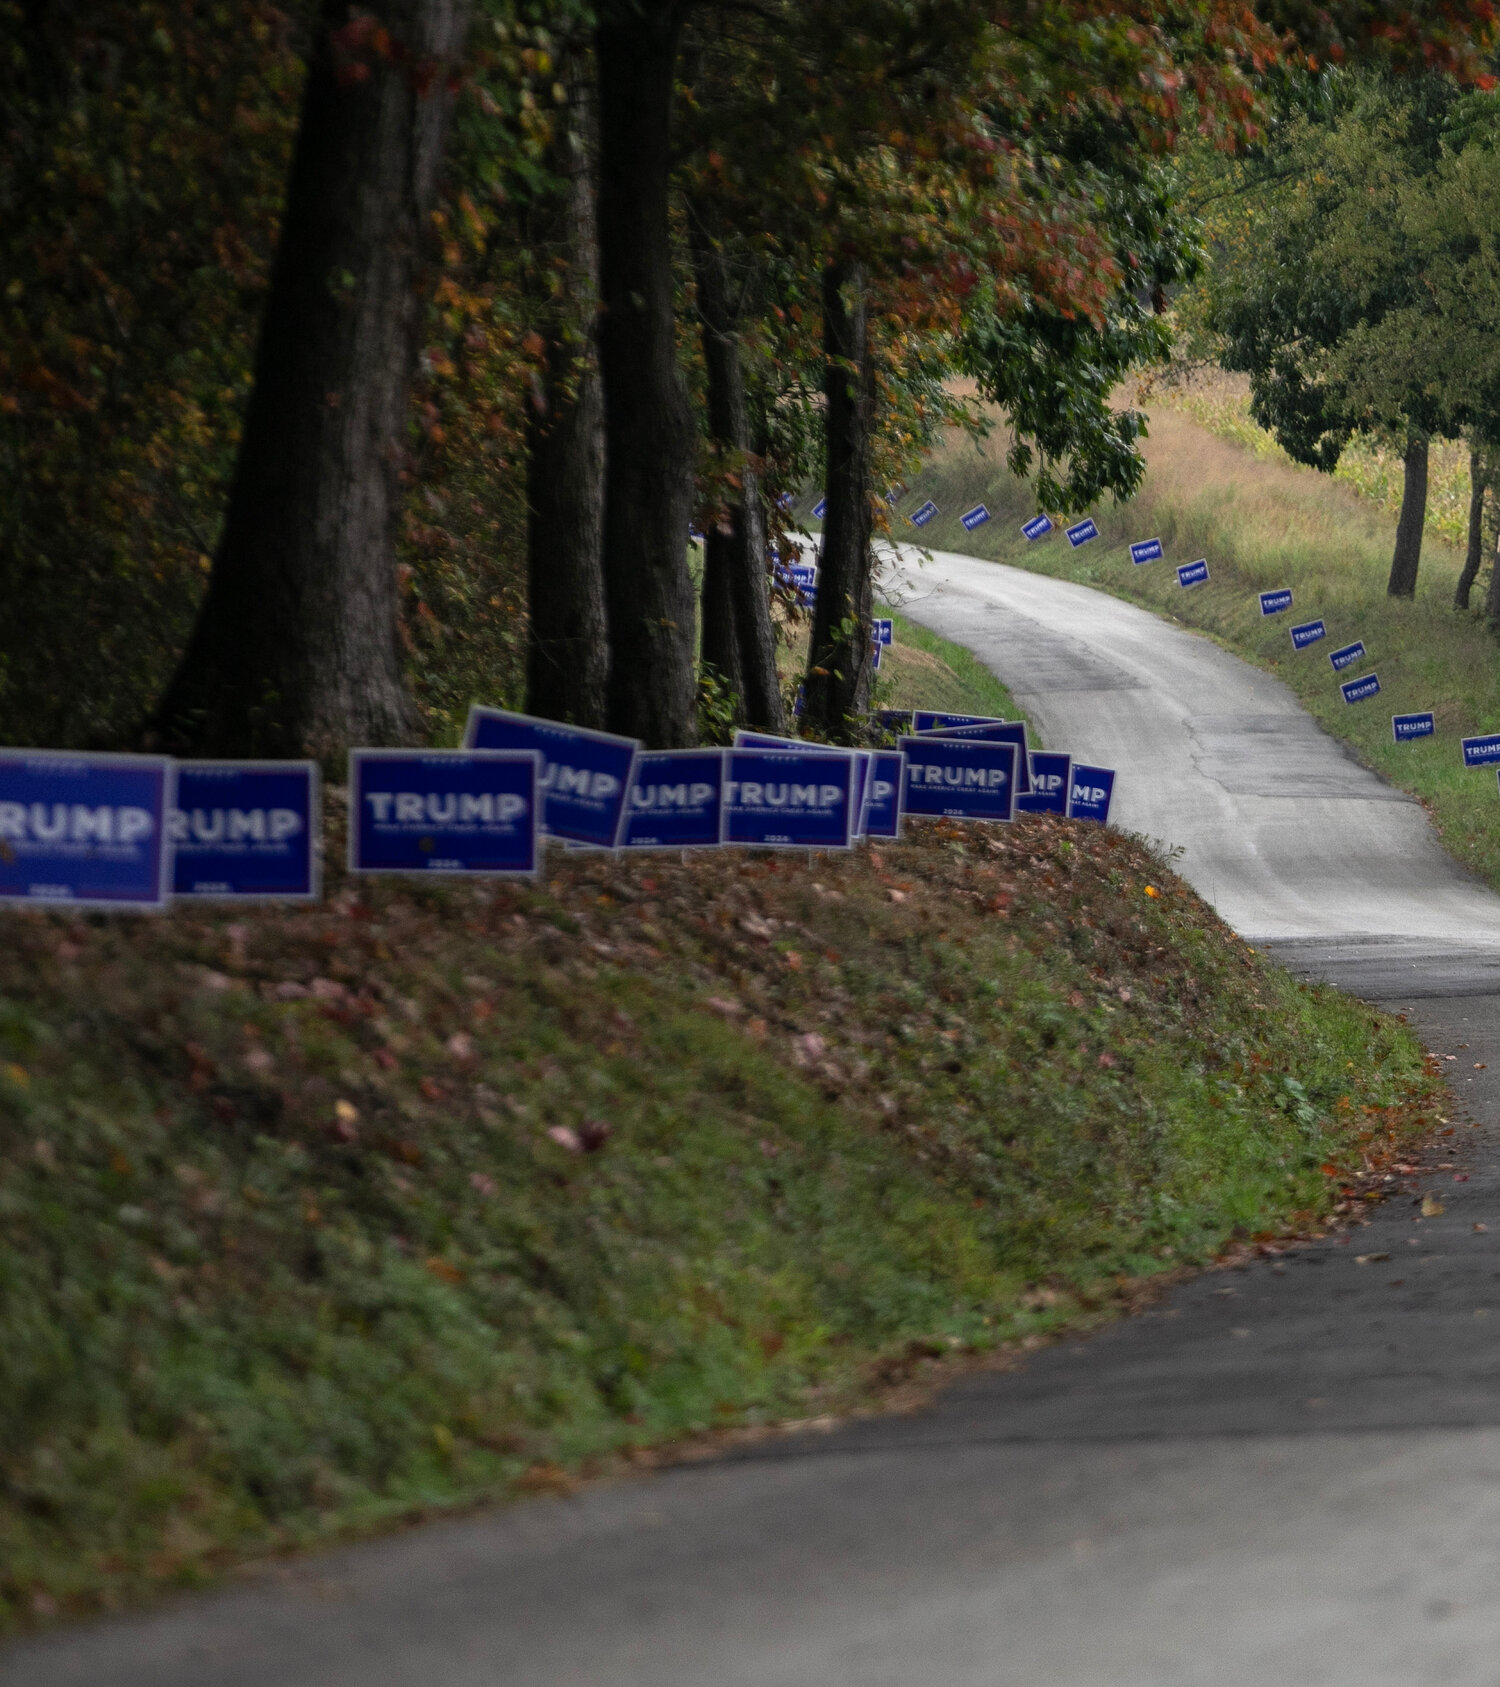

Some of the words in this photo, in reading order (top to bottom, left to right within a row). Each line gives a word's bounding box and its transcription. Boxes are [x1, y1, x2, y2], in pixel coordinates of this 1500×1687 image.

[1262, 595, 1290, 608] TRUMP
[1294, 627, 1323, 642] TRUMP
[1334, 649, 1363, 667] TRUMP
[1346, 682, 1377, 699] TRUMP
[1396, 721, 1431, 733] TRUMP
[538, 762, 621, 798] UMP
[907, 763, 1007, 790] TRUMP
[366, 792, 527, 822] TRUMP
[631, 782, 714, 807] UMP
[0, 800, 153, 841] RUMP
[166, 807, 303, 842] RUMP
